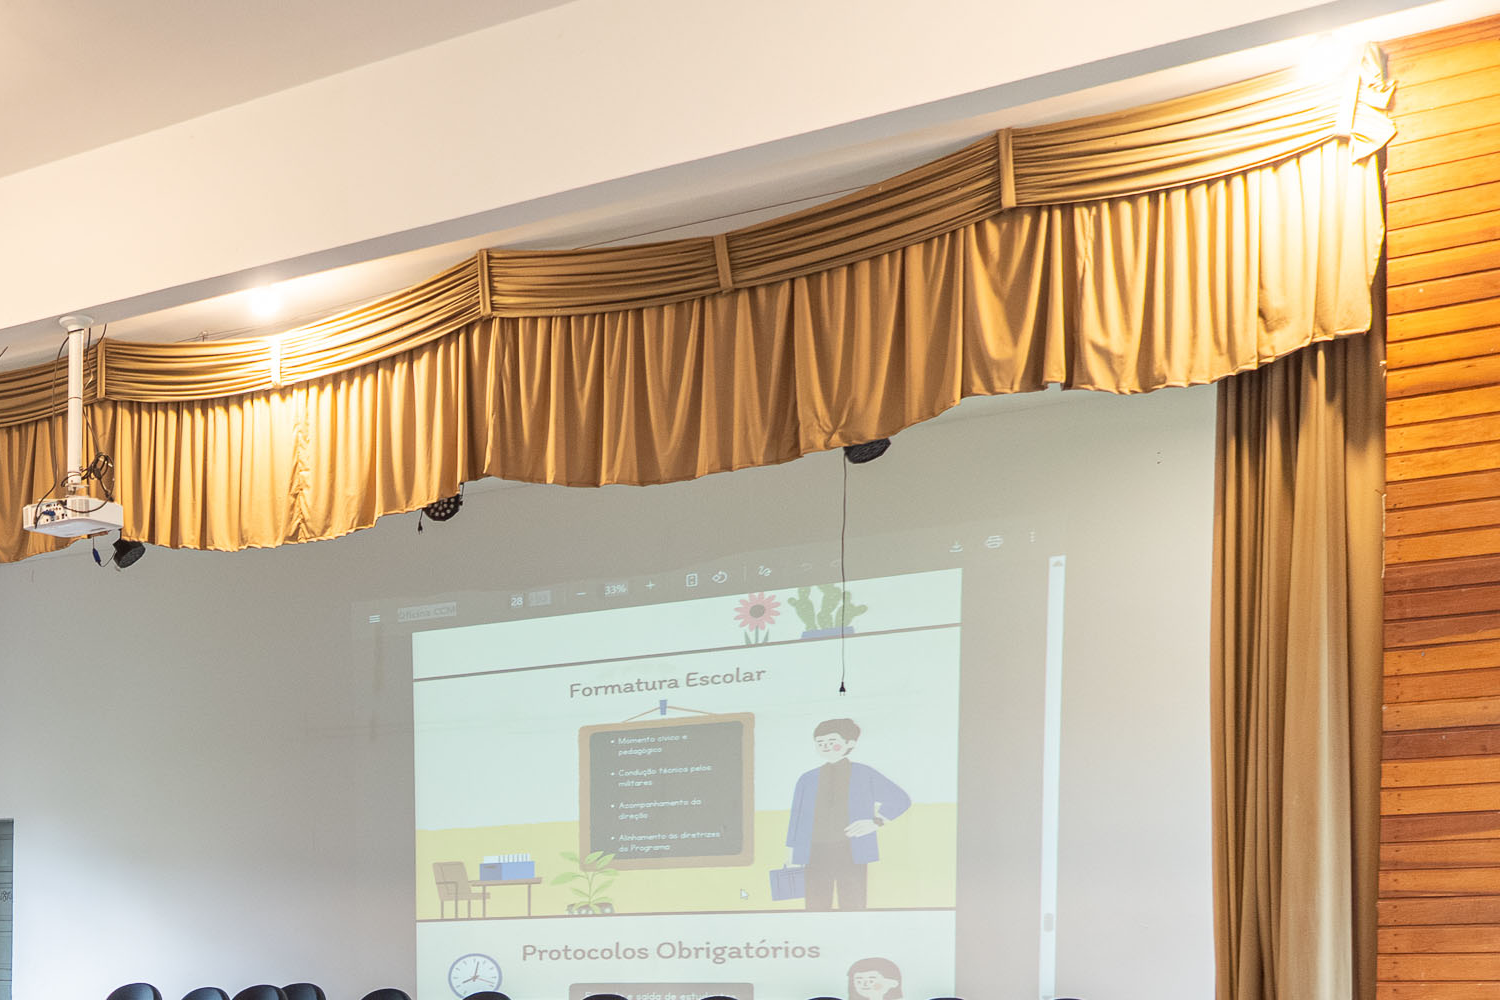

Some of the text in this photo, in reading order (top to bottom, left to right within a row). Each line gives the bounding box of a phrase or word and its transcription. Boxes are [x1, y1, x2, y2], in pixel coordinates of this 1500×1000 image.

[604, 583, 627, 595] 33%
[569, 667, 767, 698] Formatura Escolar
[618, 736, 656, 745] Momento
[618, 768, 657, 777] Condução
[618, 779, 653, 787] militares
[630, 843, 671, 853] Programa
[522, 939, 821, 964] Protocolos Obrigatórios
